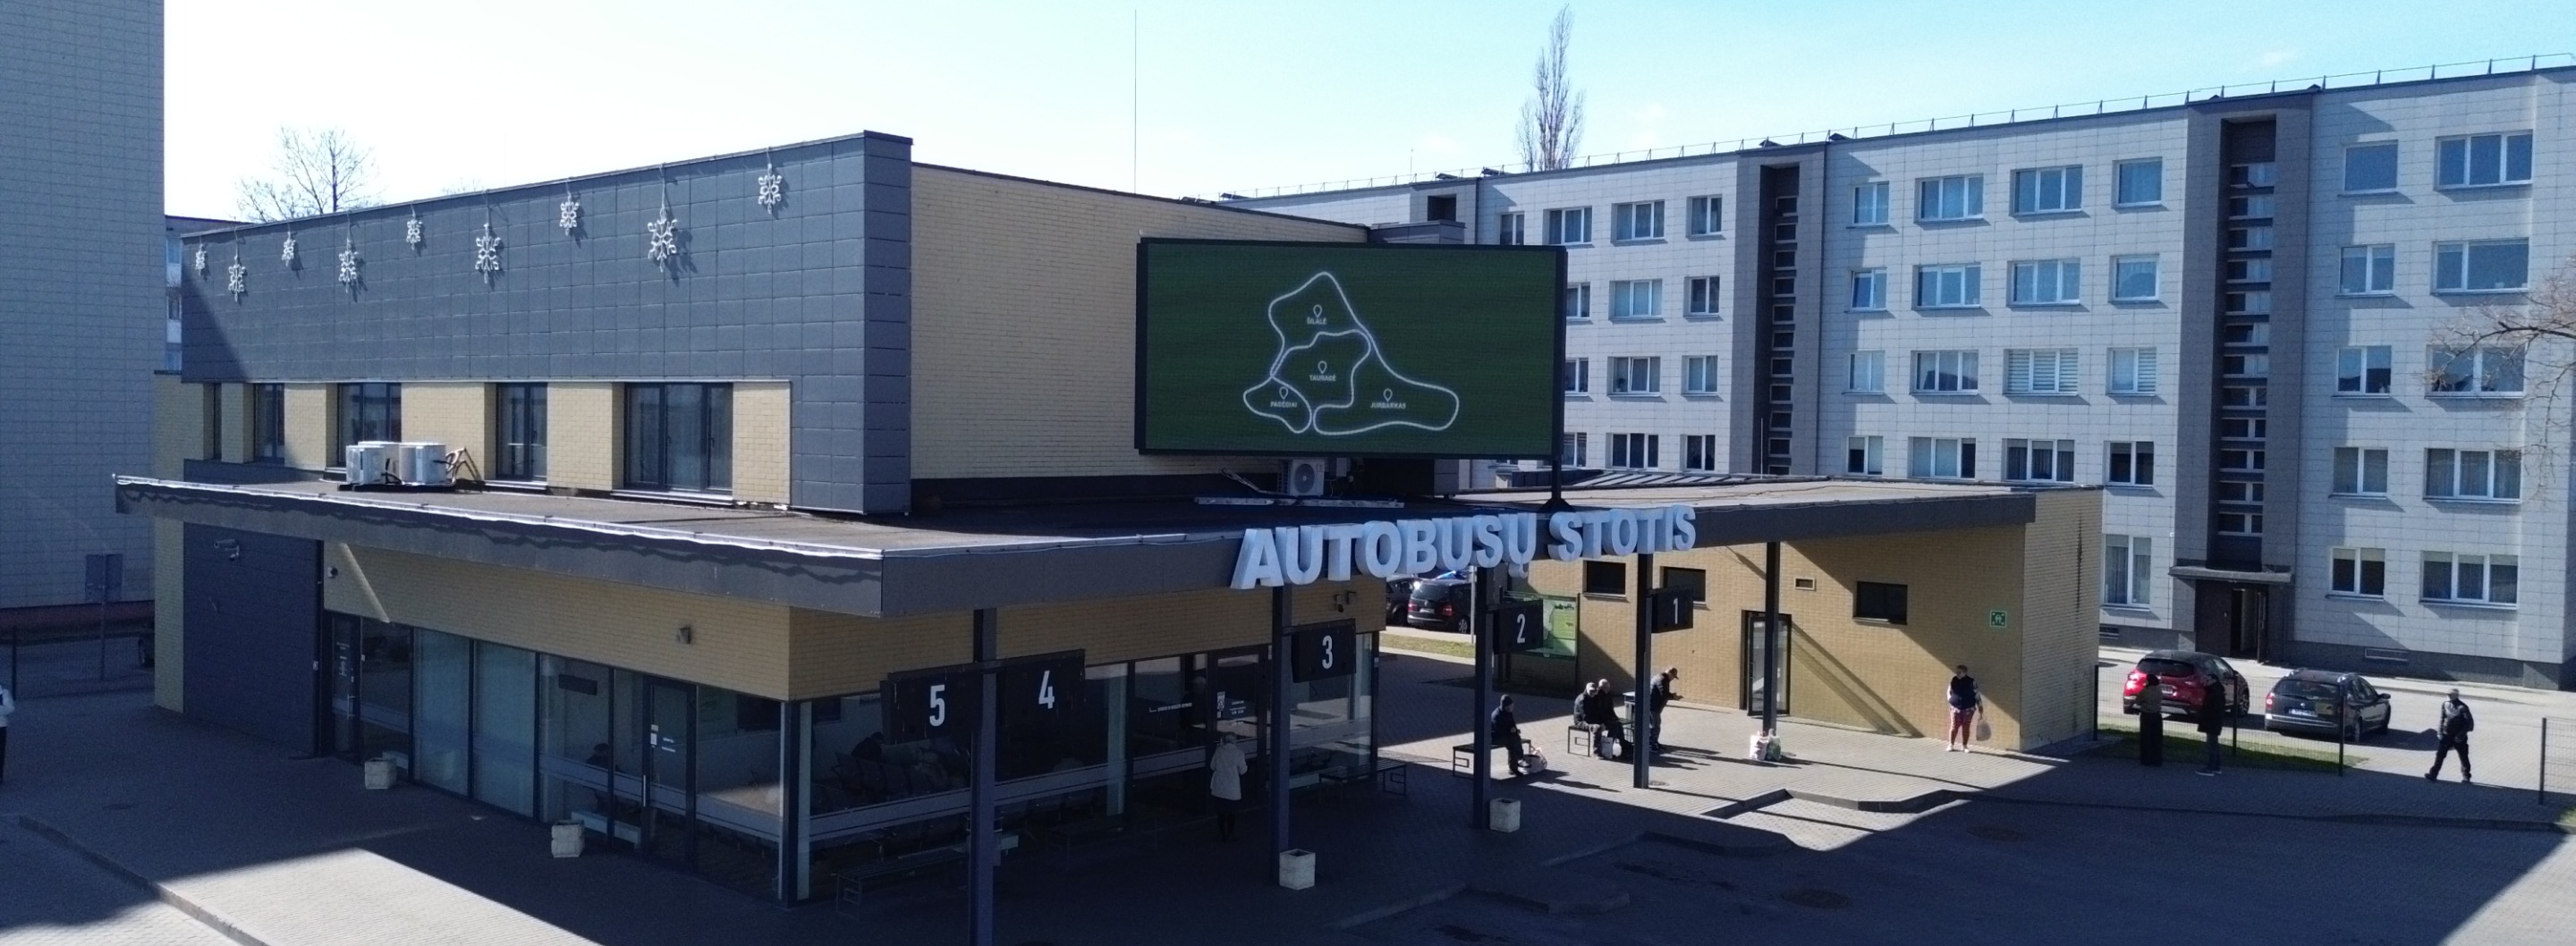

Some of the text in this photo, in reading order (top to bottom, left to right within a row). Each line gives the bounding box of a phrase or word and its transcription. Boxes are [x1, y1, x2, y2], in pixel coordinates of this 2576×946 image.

[1548, 503, 1697, 562] STOTIS
[1516, 613, 1526, 644] 2
[1672, 597, 1679, 625] 1
[1321, 635, 1334, 671] 3
[928, 684, 945, 727] 5
[1038, 670, 1055, 710] 4
